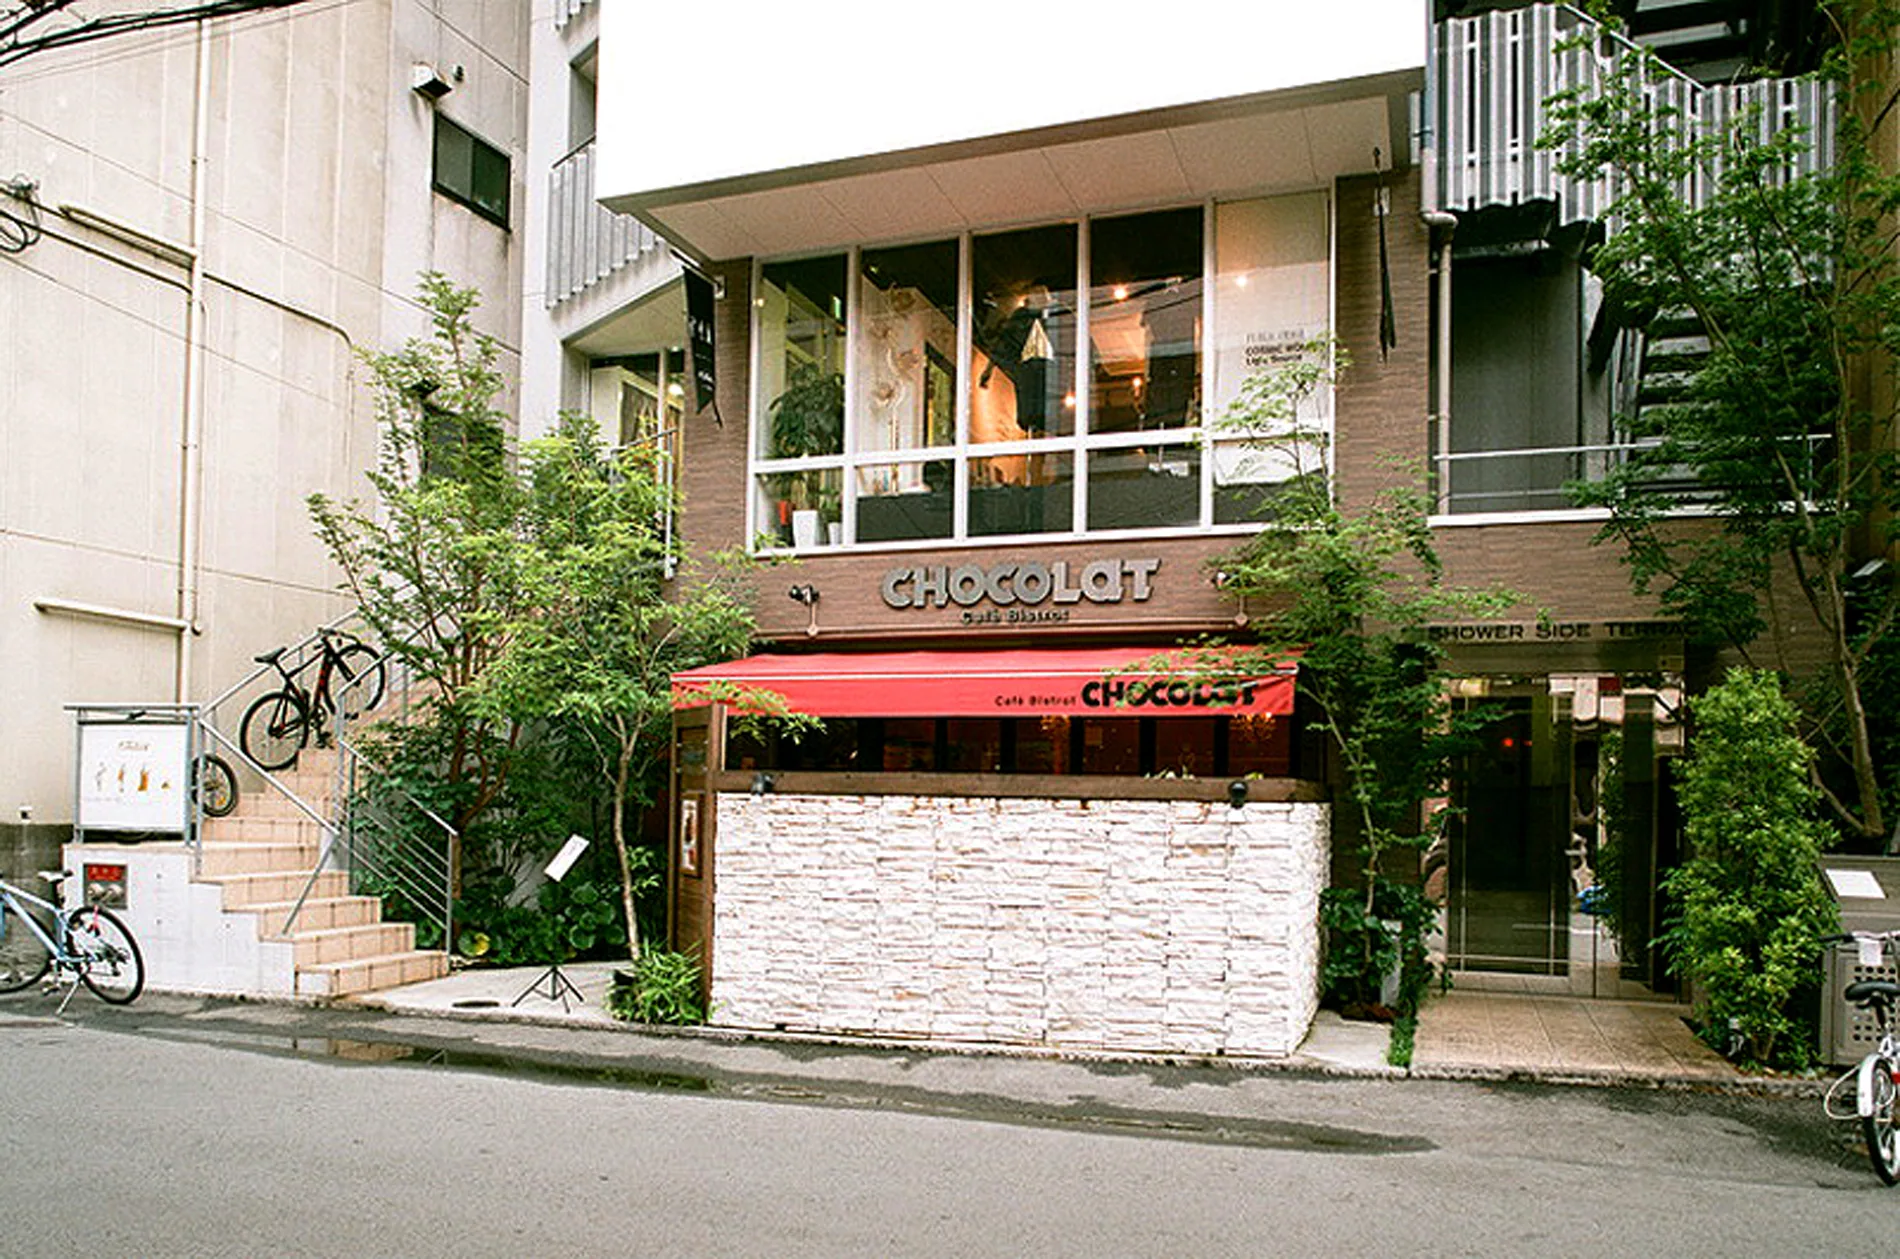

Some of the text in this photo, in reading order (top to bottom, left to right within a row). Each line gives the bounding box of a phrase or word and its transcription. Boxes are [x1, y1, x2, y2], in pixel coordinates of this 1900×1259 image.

[1428, 622, 1701, 641] SHOWER SIDE TERRAC
